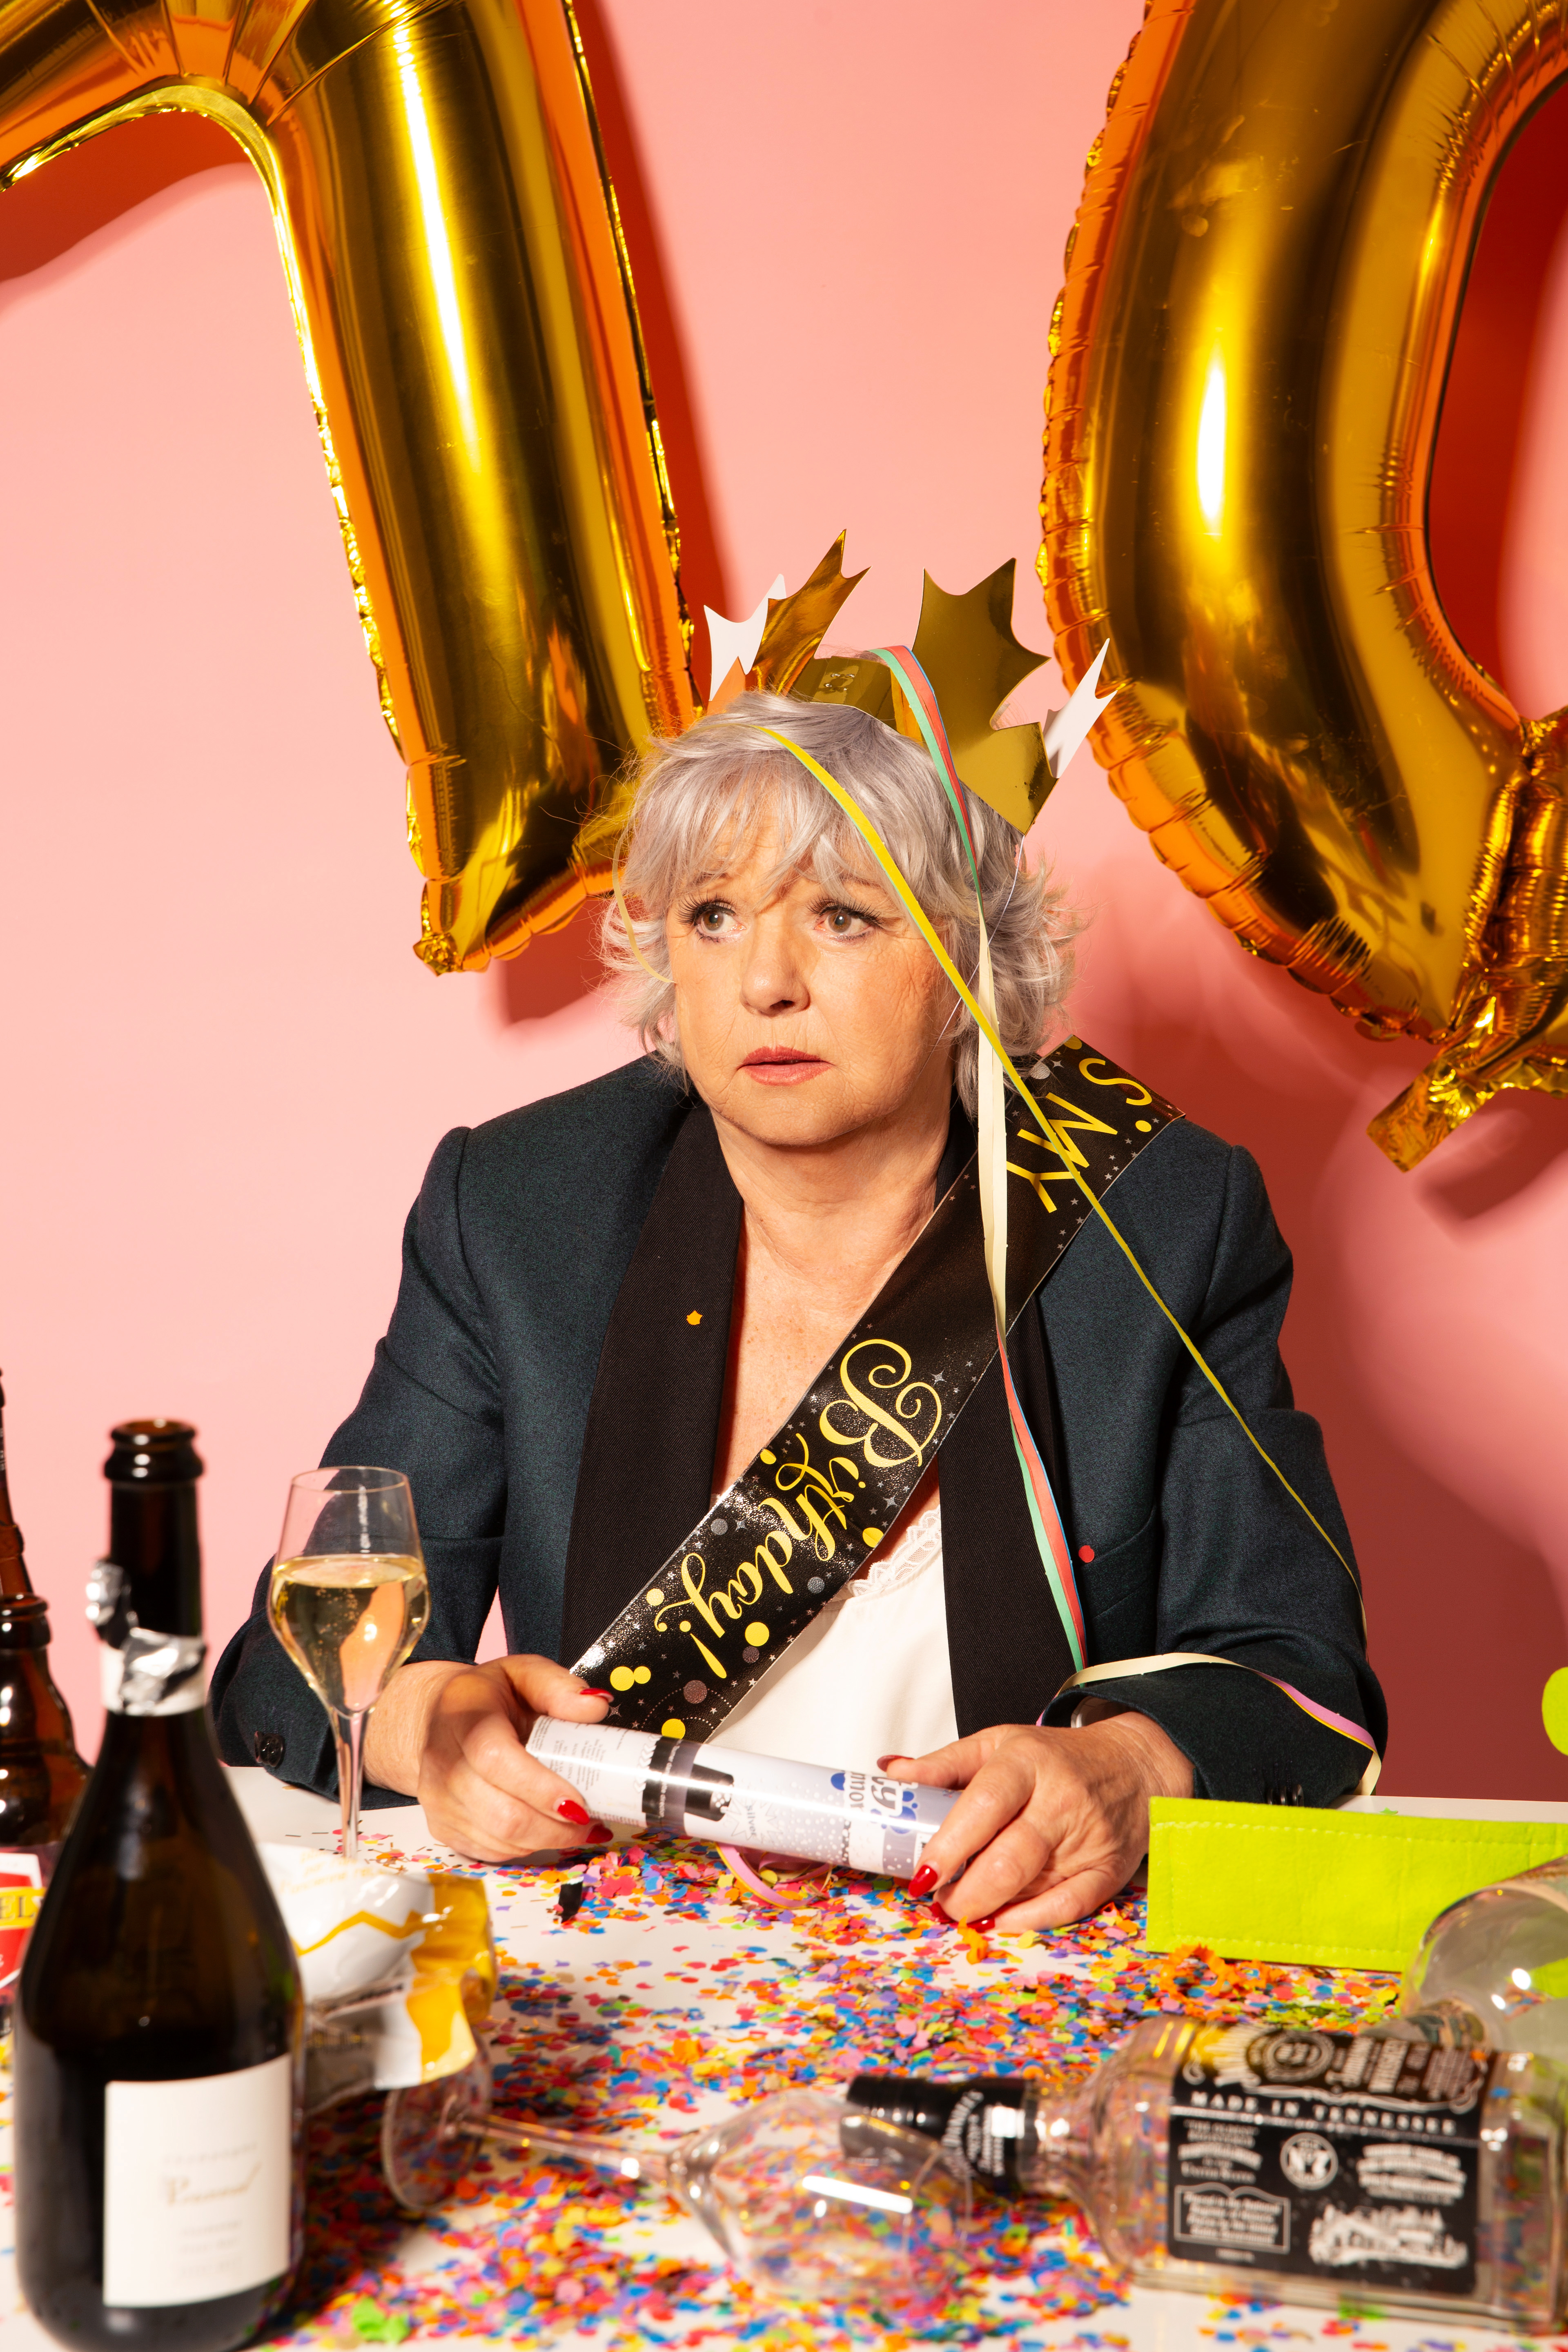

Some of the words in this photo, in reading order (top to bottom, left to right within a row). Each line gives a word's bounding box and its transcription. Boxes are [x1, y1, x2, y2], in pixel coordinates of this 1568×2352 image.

[654, 1339, 942, 1679] Birthday!
[745, 1805, 758, 1835] silver
[1192, 2092, 1257, 2111] MADE
[1272, 2101, 1298, 2116] IN
[1314, 2106, 1455, 2134] TENNESSEE
